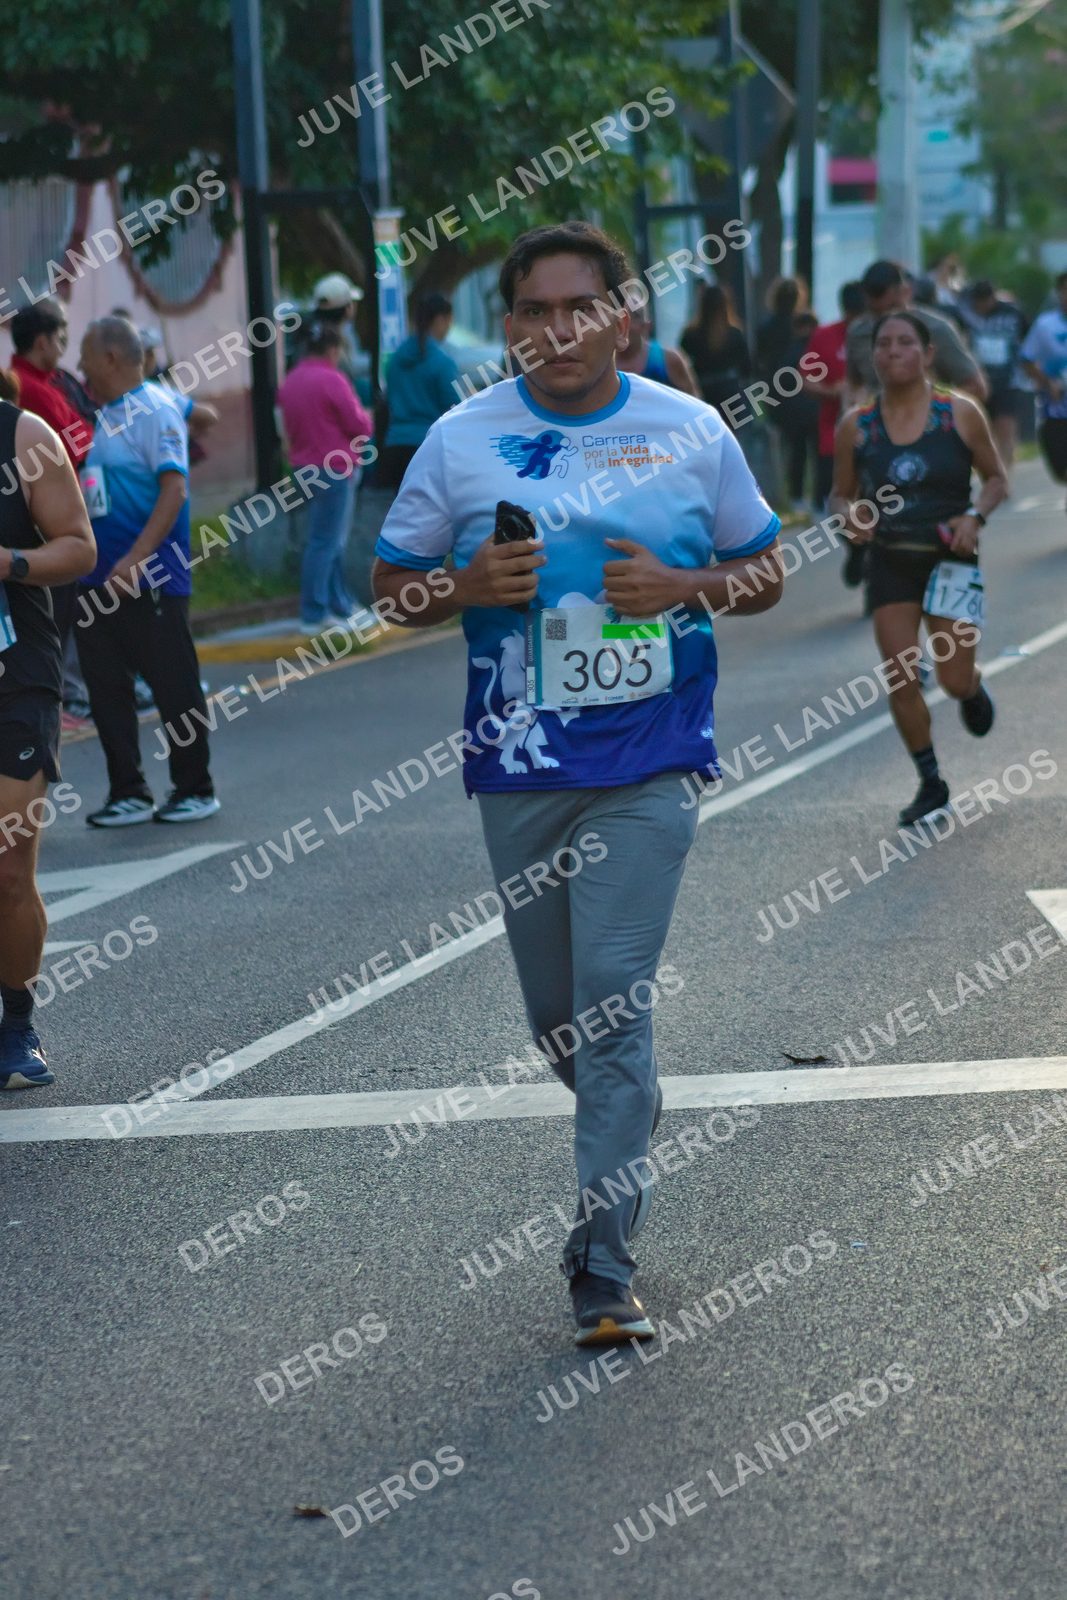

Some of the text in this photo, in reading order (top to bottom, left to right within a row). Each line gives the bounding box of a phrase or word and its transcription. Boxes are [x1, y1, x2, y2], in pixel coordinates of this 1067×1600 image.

[582, 434, 646, 447] Carrera
[584, 445, 649, 461] por la Vida
[584, 453, 673, 472] y la Integridad
[562, 644, 653, 693] 305
[527, 679, 535, 694] 305
